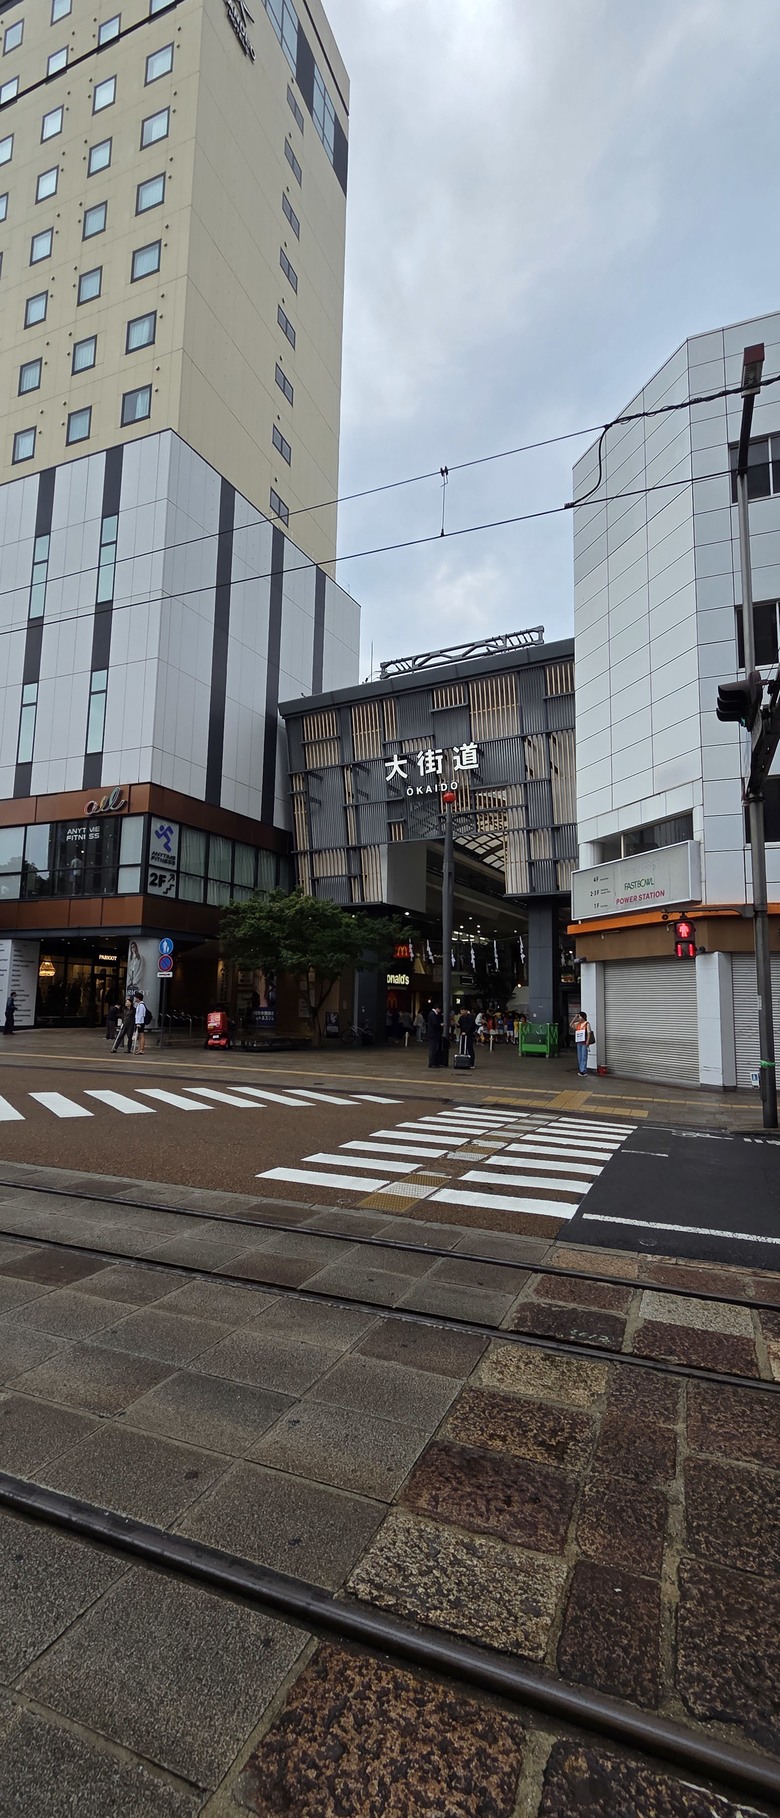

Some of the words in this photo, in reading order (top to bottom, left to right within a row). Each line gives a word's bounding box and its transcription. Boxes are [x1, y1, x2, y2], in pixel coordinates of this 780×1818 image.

[385, 742, 479, 781] 大街道
[67, 826, 100, 834] ANYTME
[150, 855, 176, 866] FITNESS
[151, 851, 176, 861] ANYTIME
[149, 871, 167, 888] 2F
[624, 878, 654, 890] FASTBOWL
[616, 894, 637, 904] POWER
[638, 890, 665, 901] STATION
